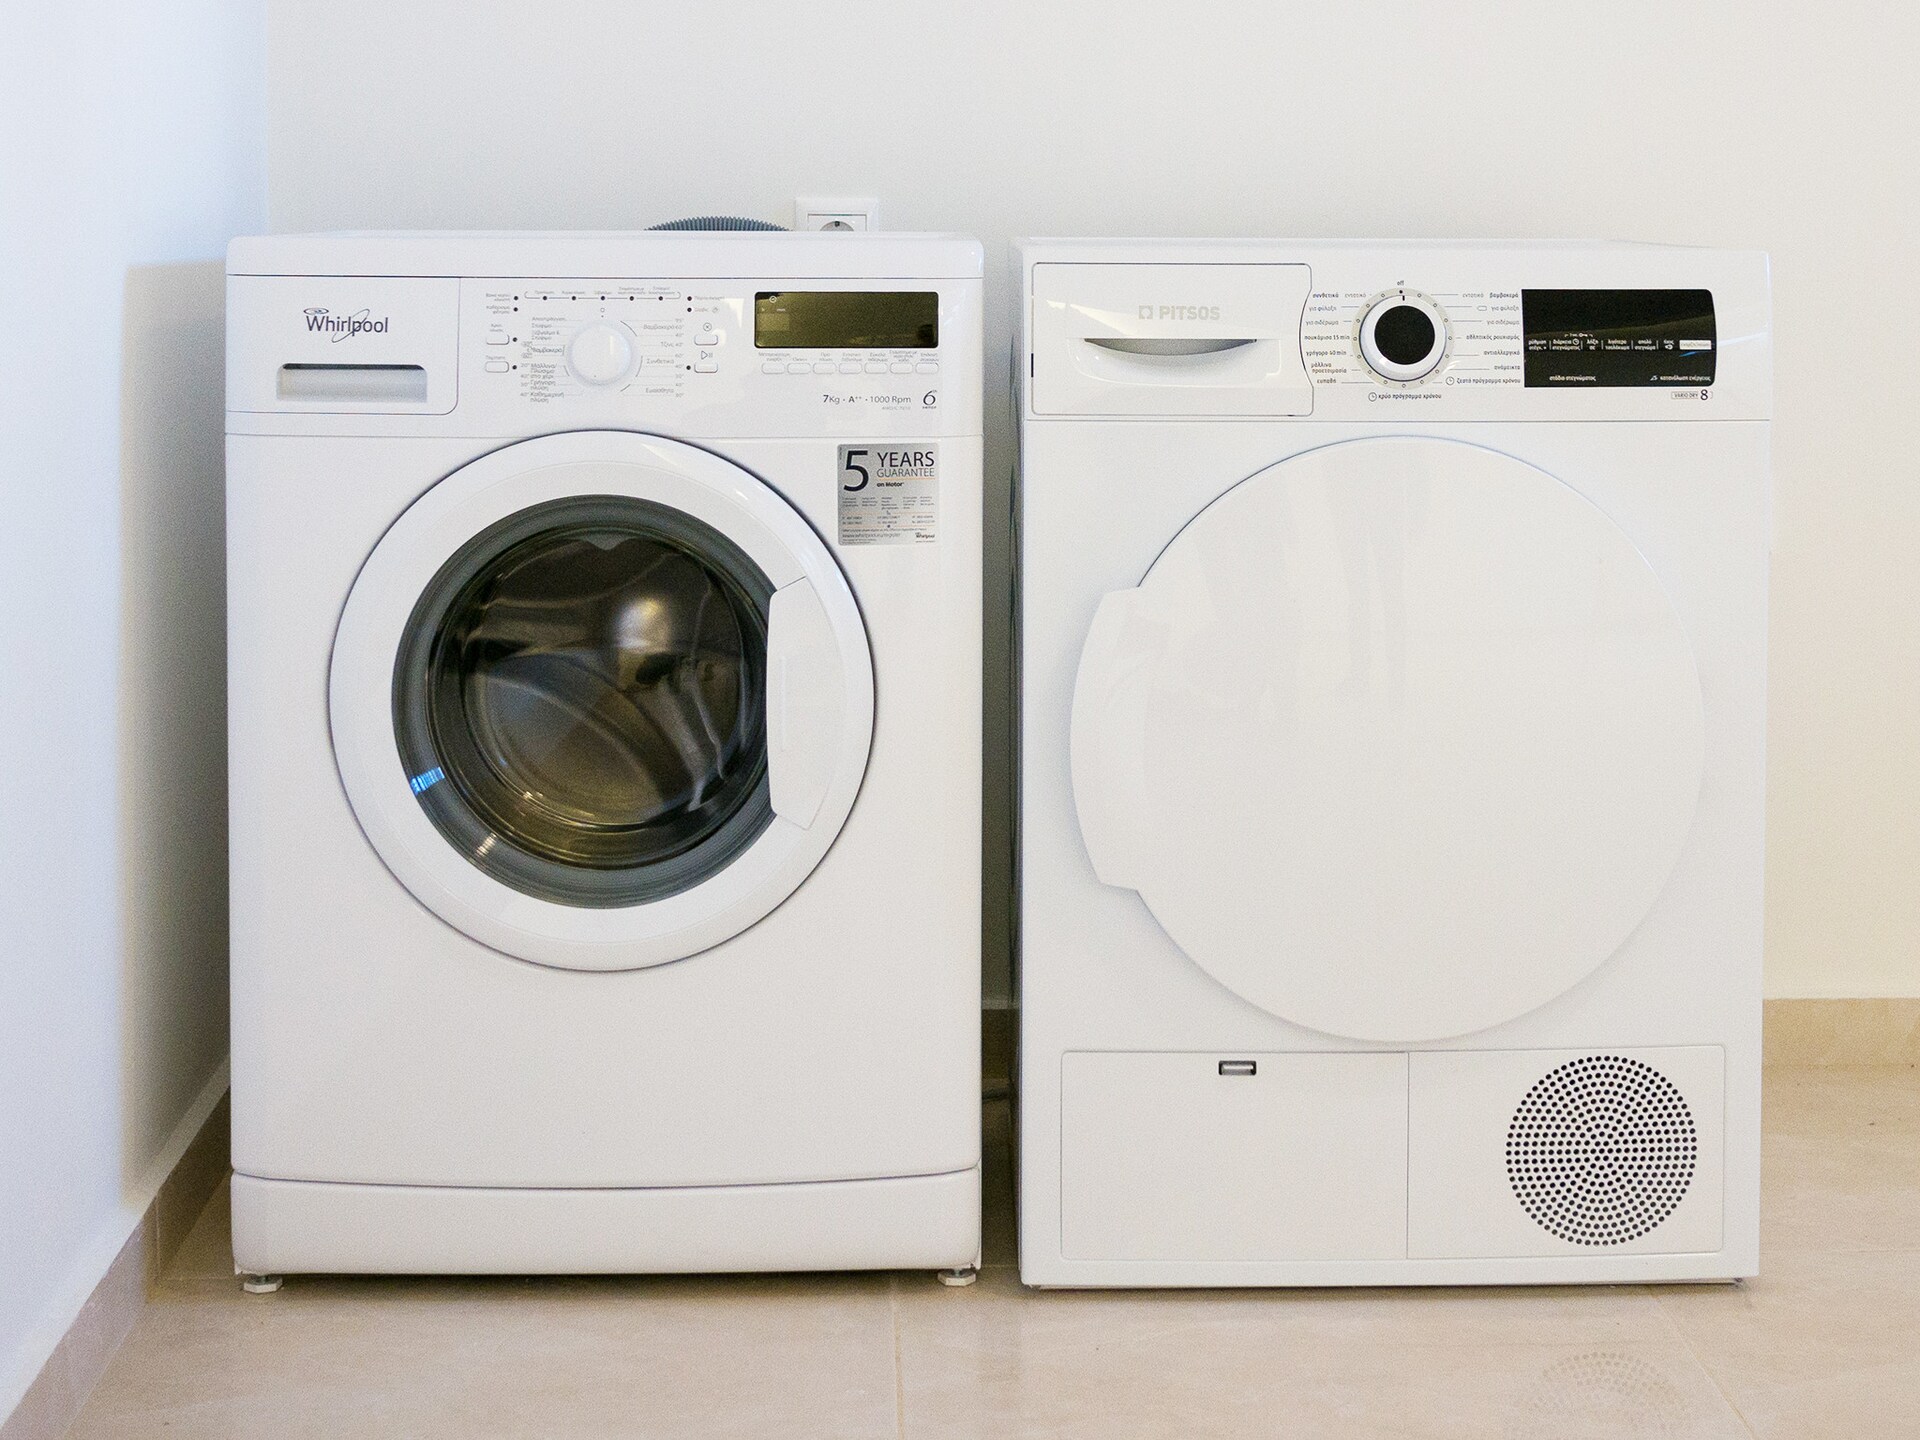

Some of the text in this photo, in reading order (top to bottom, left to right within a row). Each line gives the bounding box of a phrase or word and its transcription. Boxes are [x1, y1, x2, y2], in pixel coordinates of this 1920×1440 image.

[1159, 305, 1220, 320] PITSOS
[304, 311, 388, 338] Whirlpool
[870, 395, 890, 403] 1000
[891, 395, 912, 404] Rpm
[1700, 388, 1708, 400] 8
[844, 450, 869, 492] 5
[876, 452, 935, 468] YEARS
[876, 468, 935, 478] GUARANTEE
